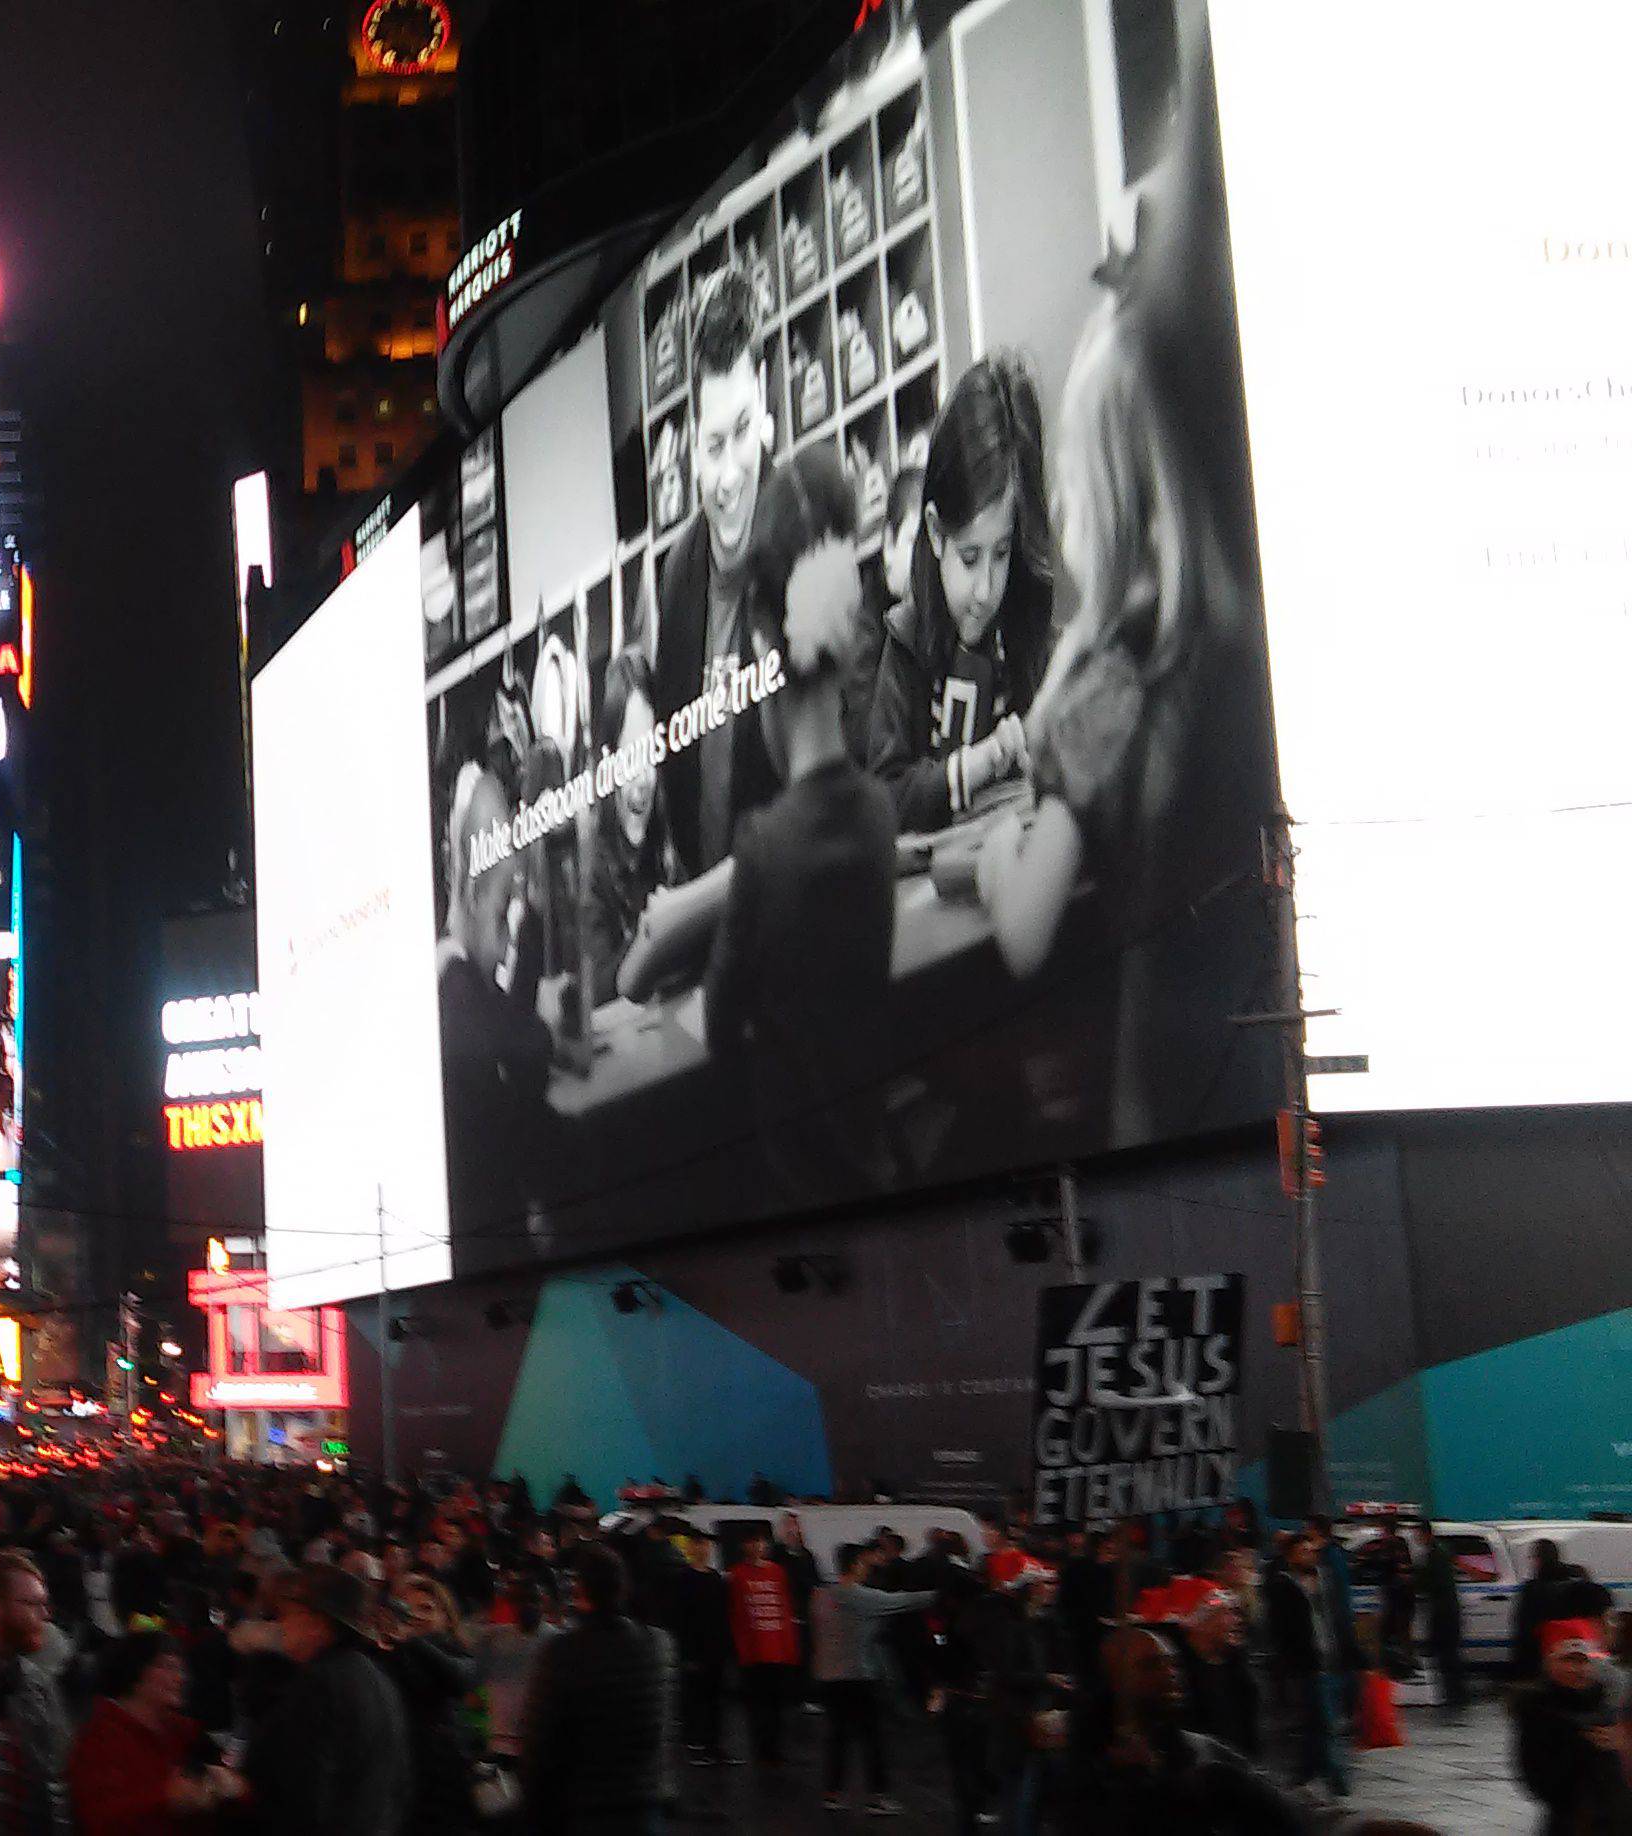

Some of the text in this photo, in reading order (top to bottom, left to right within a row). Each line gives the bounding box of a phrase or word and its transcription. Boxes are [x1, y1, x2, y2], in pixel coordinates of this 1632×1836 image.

[448, 208, 523, 301] MARRIOTT
[449, 247, 512, 330] MARQUIS
[469, 648, 786, 878] Make classroom dreams come true.
[1044, 1331, 1236, 1408] JESUS
[1035, 1394, 1234, 1467] GOVERN
